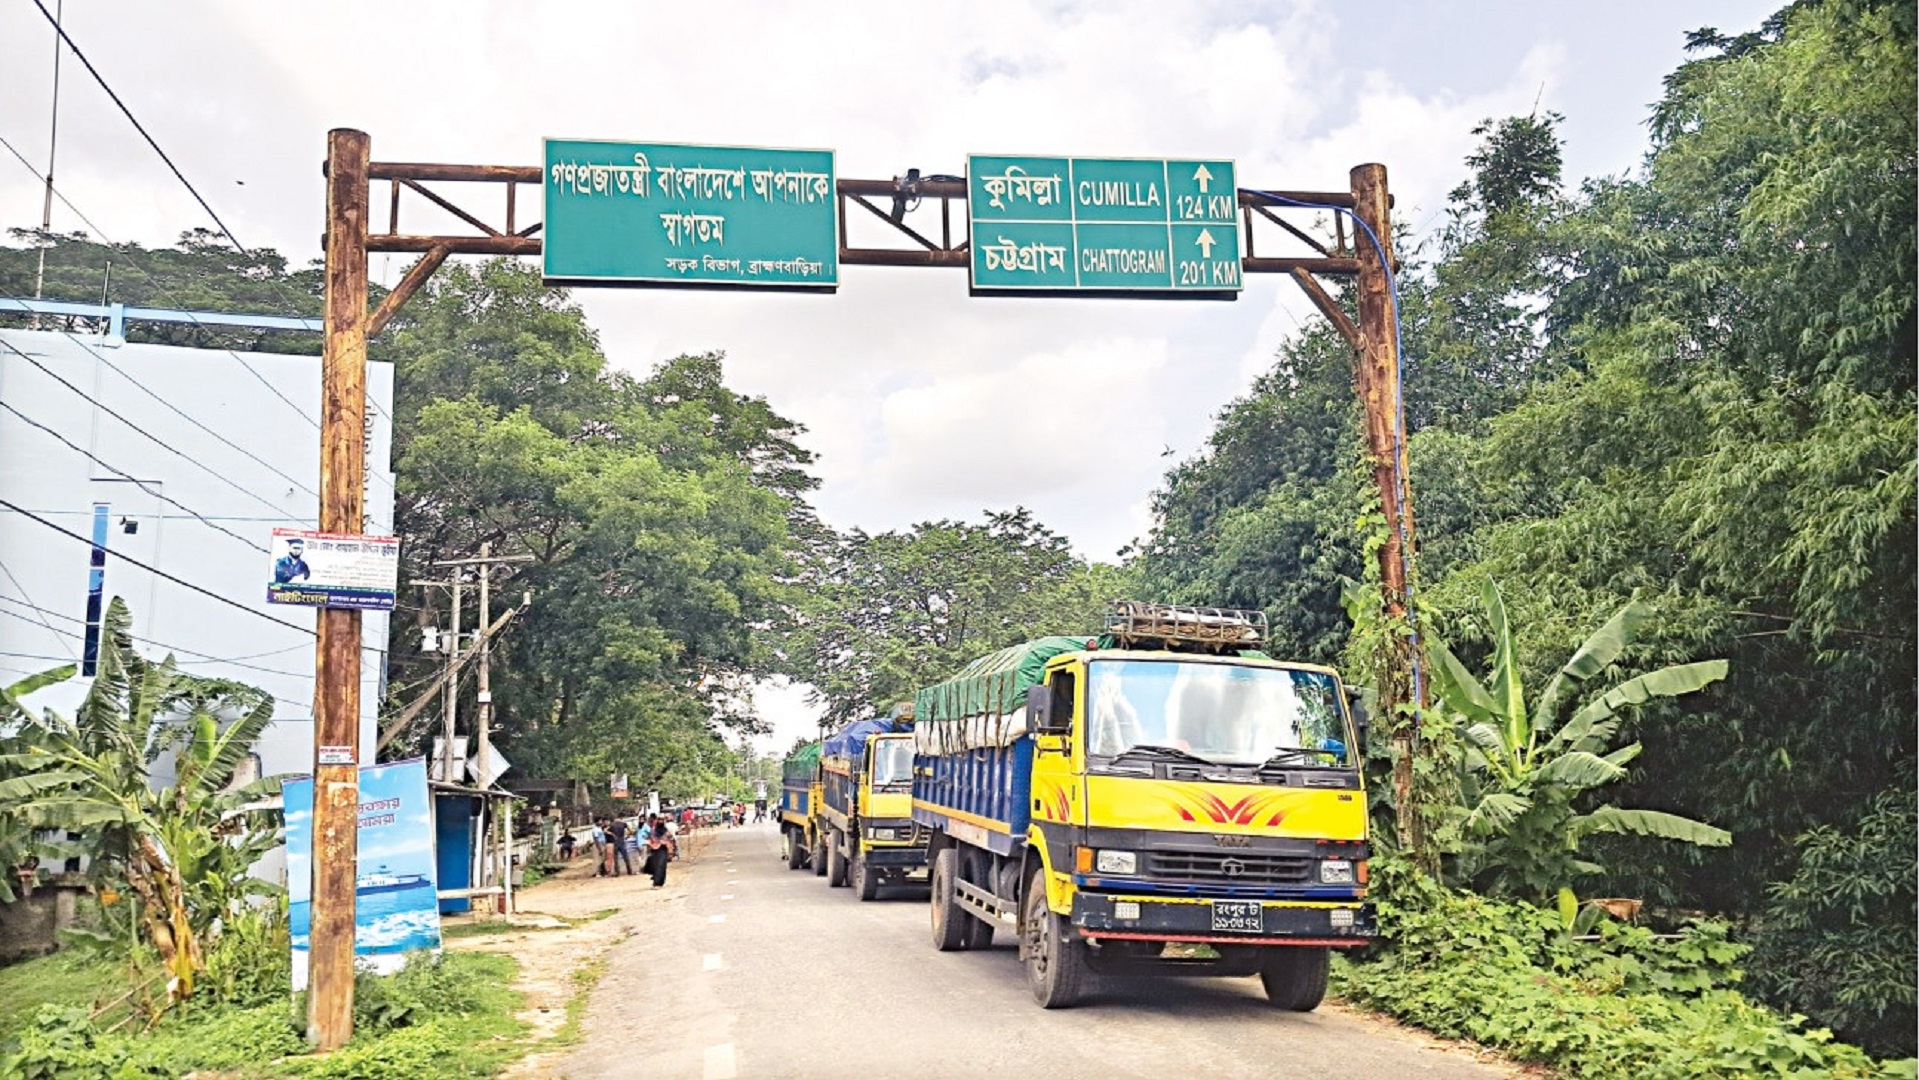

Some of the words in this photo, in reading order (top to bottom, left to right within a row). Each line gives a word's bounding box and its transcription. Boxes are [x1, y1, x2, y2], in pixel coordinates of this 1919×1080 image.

[552, 152, 651, 198] গণপ্রজাতন্ত্রী
[655, 163, 745, 201] বাংলাদেশে
[750, 167, 829, 204] আপনাকে
[980, 166, 1063, 211] কুমিল্লা
[1079, 181, 1161, 206] CUMILLA
[1177, 195, 1204, 220] 124
[1208, 196, 1233, 219] KM
[660, 209, 725, 247] স্বাগতম
[664, 258, 698, 273] সড়ক
[981, 235, 1067, 274] চট্টগ্রাম
[1082, 248, 1165, 274] CHATTOGRAM
[1180, 261, 1207, 286] 201
[1212, 261, 1237, 285] KM
